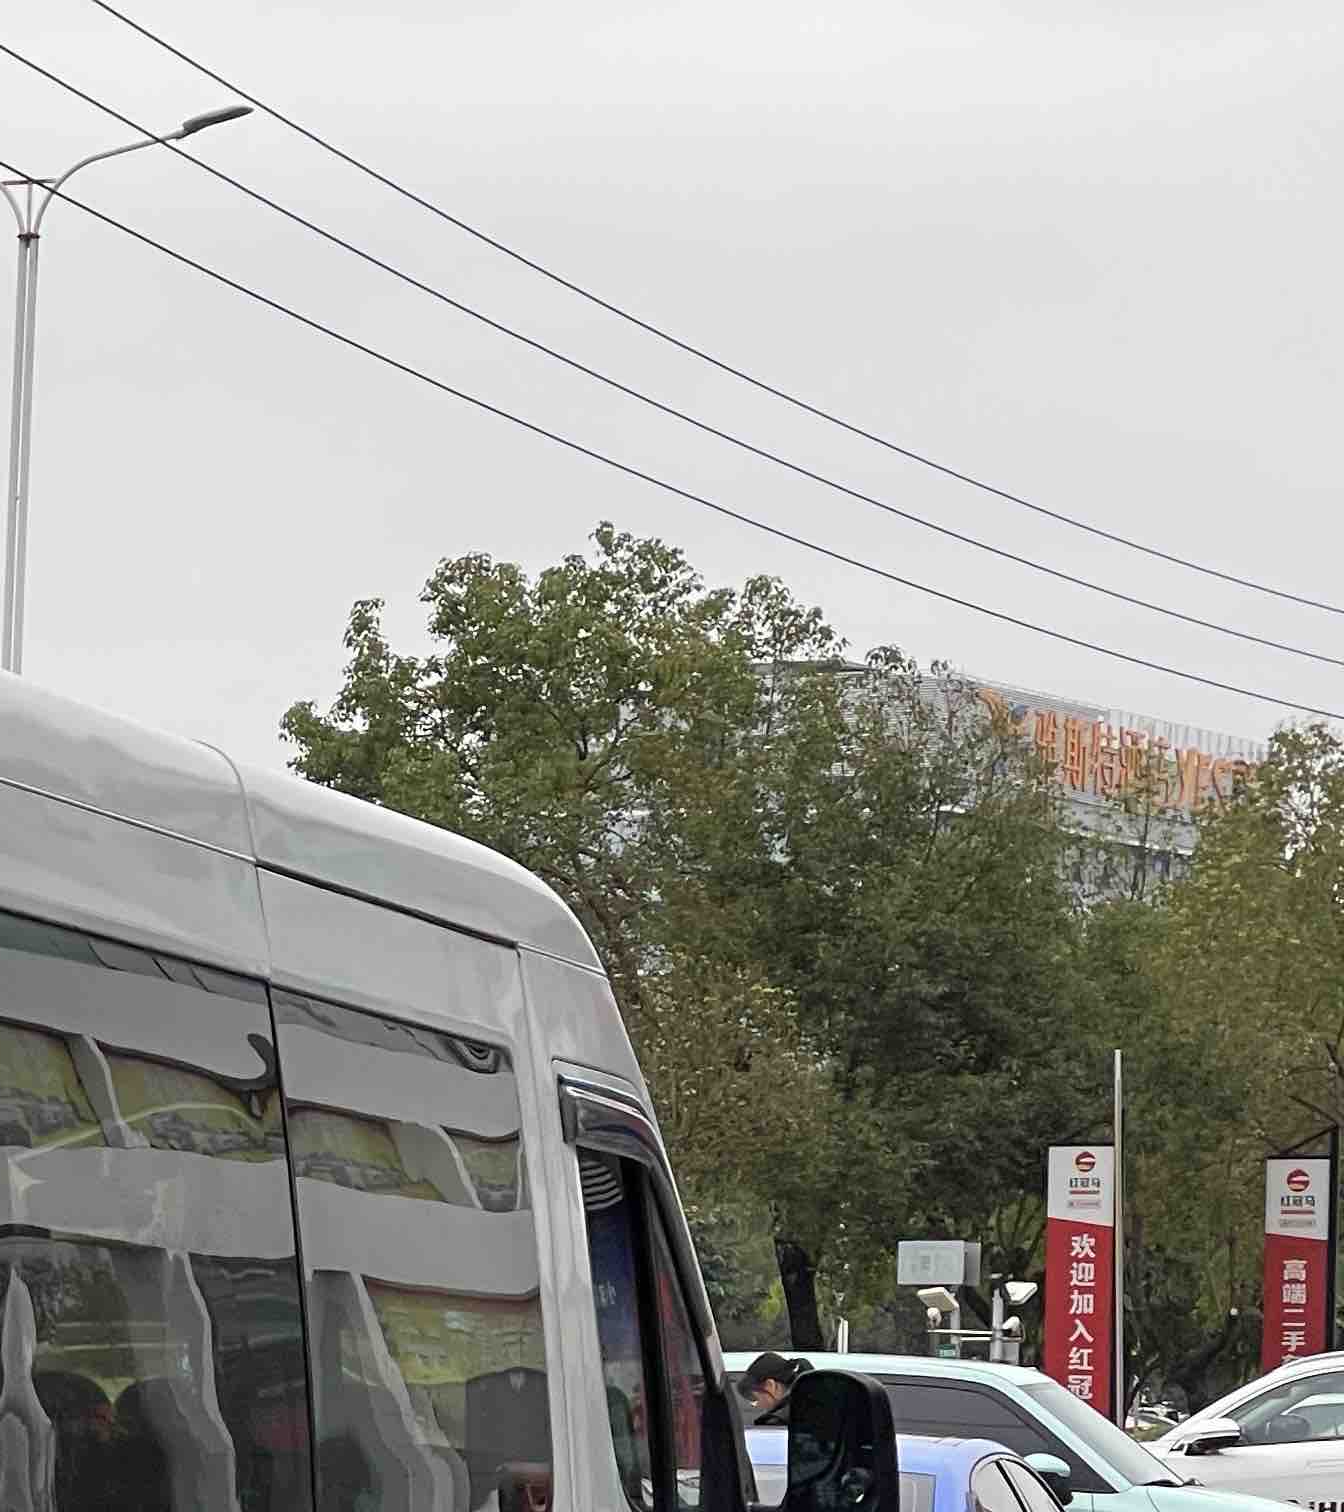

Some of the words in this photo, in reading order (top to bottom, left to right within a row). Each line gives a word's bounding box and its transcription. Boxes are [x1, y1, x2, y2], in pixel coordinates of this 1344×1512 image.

[1068, 1233, 1096, 1399] 欢迎加入红冠
